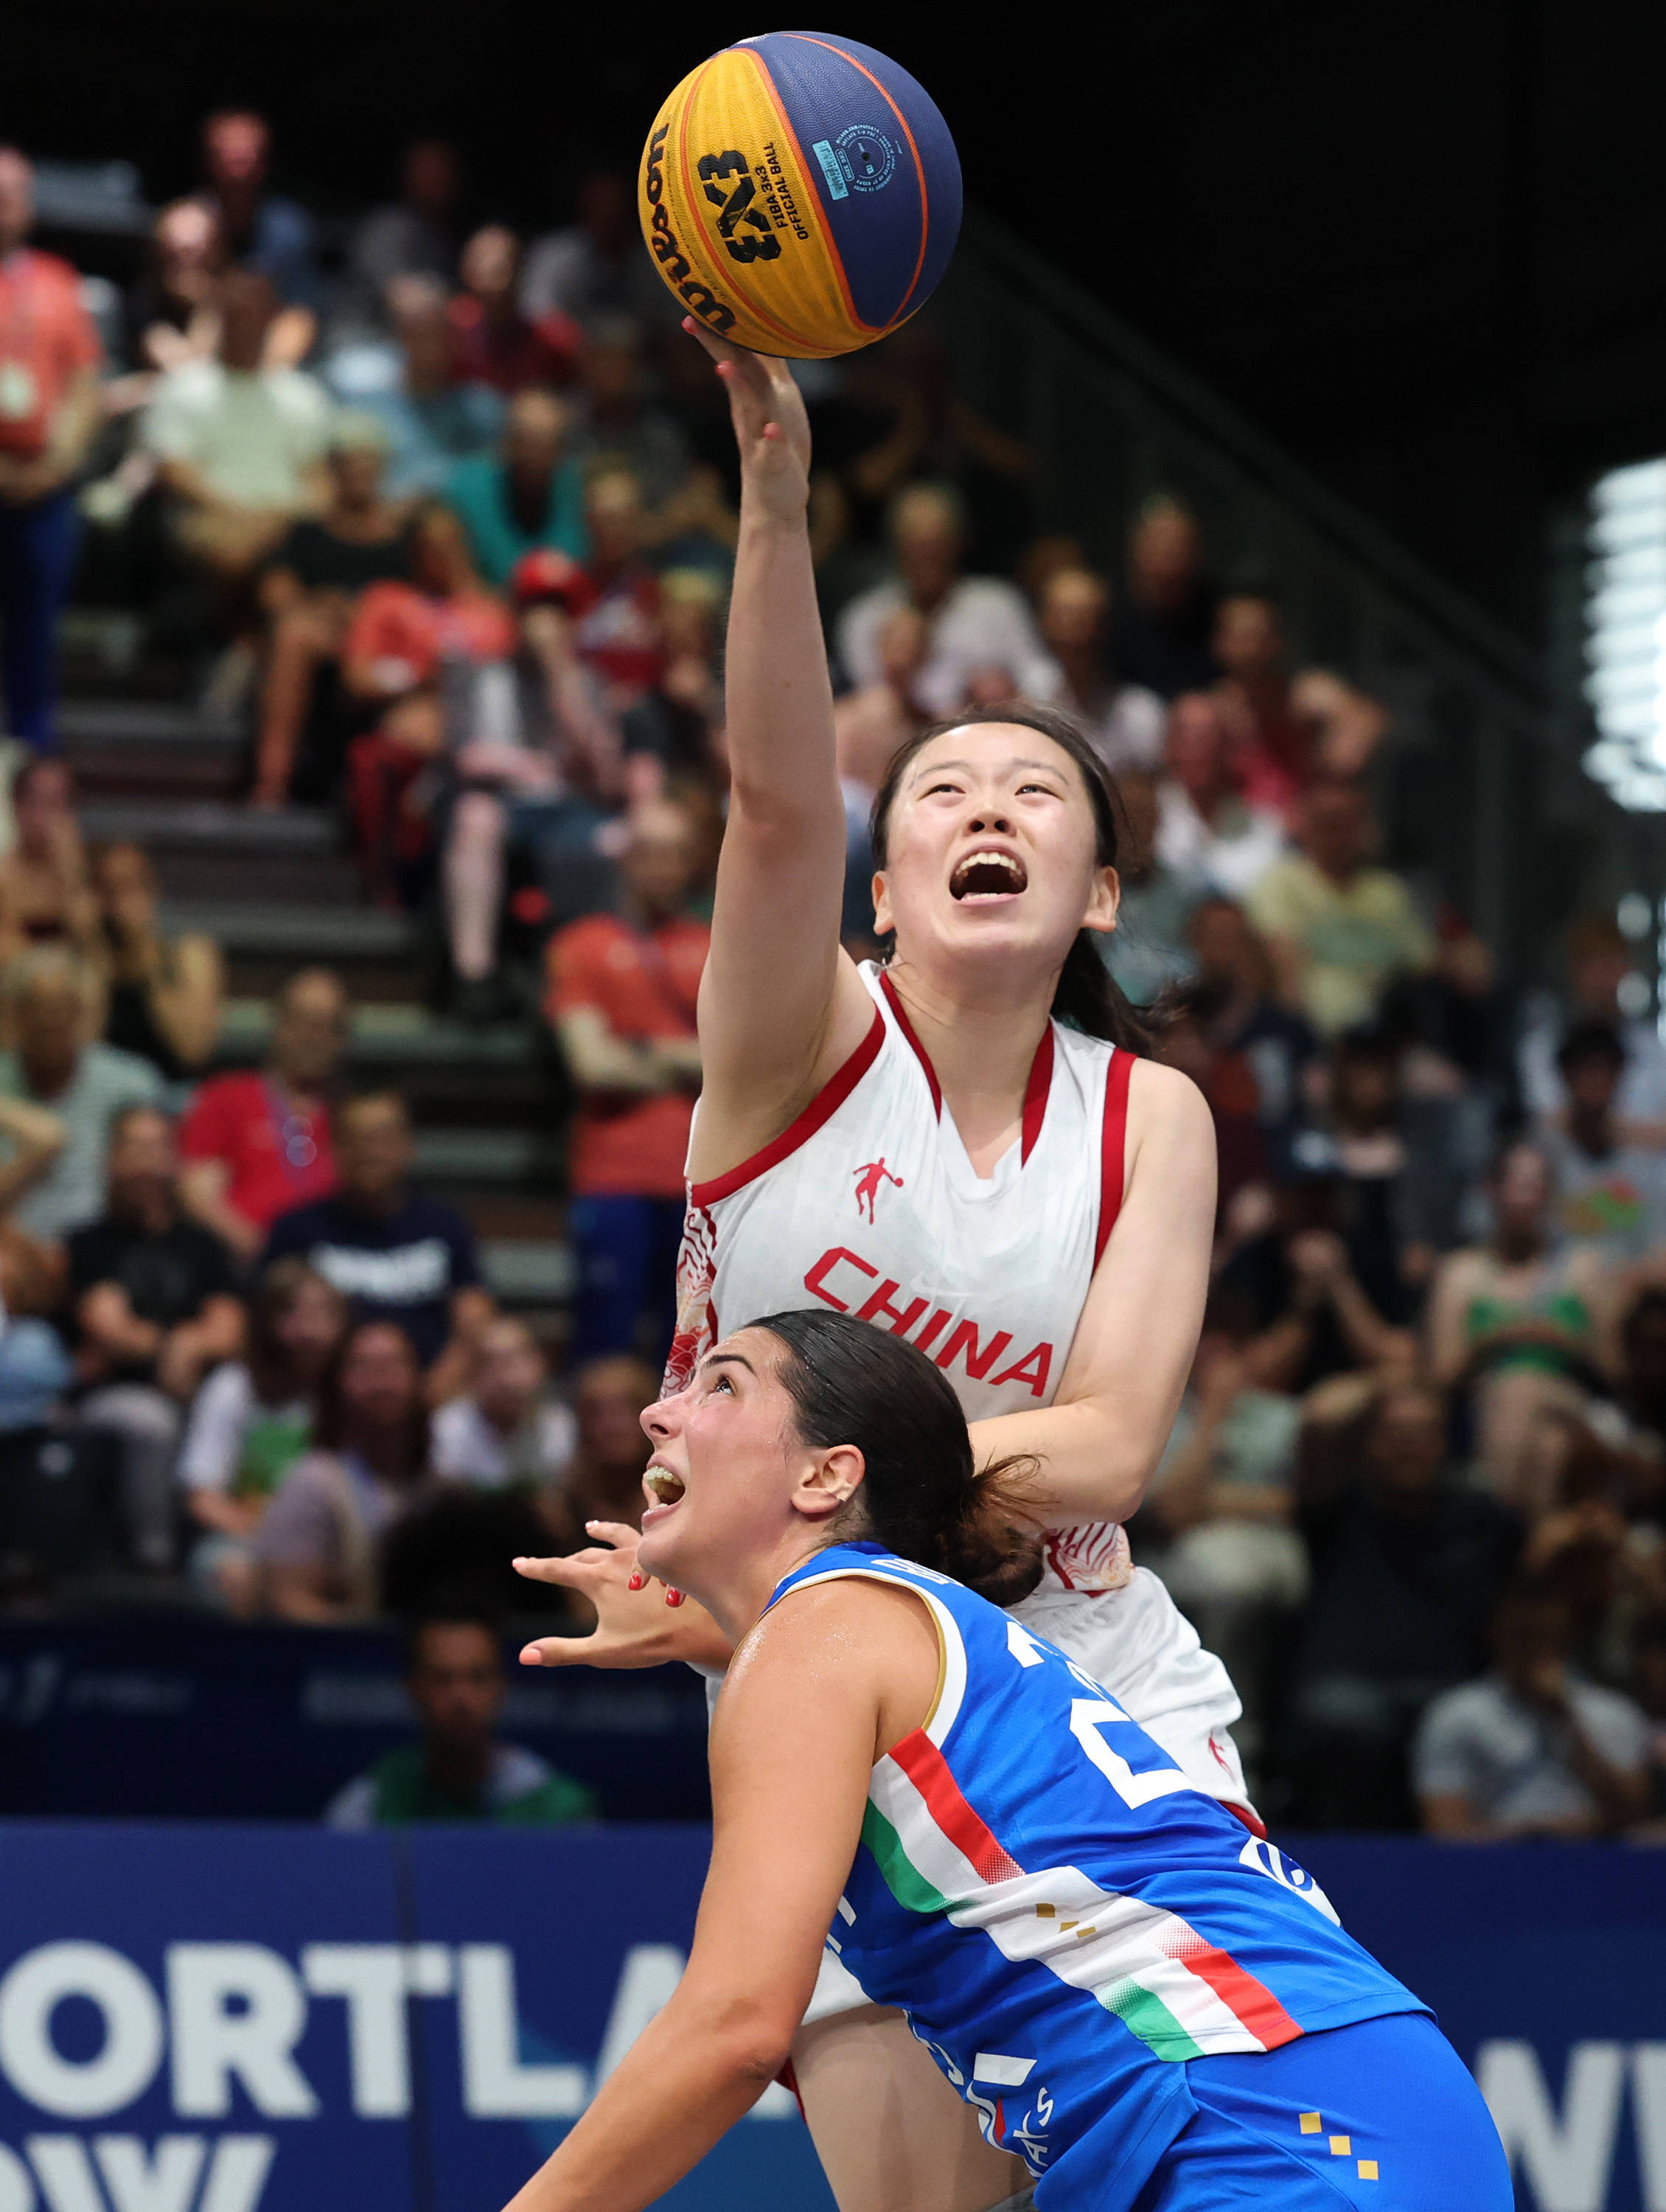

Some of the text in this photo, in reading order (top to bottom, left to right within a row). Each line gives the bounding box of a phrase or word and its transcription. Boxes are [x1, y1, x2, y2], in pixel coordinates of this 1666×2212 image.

[646, 123, 736, 336] Wilson
[764, 137, 809, 240] OFFICIAL BALL
[767, 195, 788, 229] FIBA
[804, 1246, 1053, 1398] CHINA
